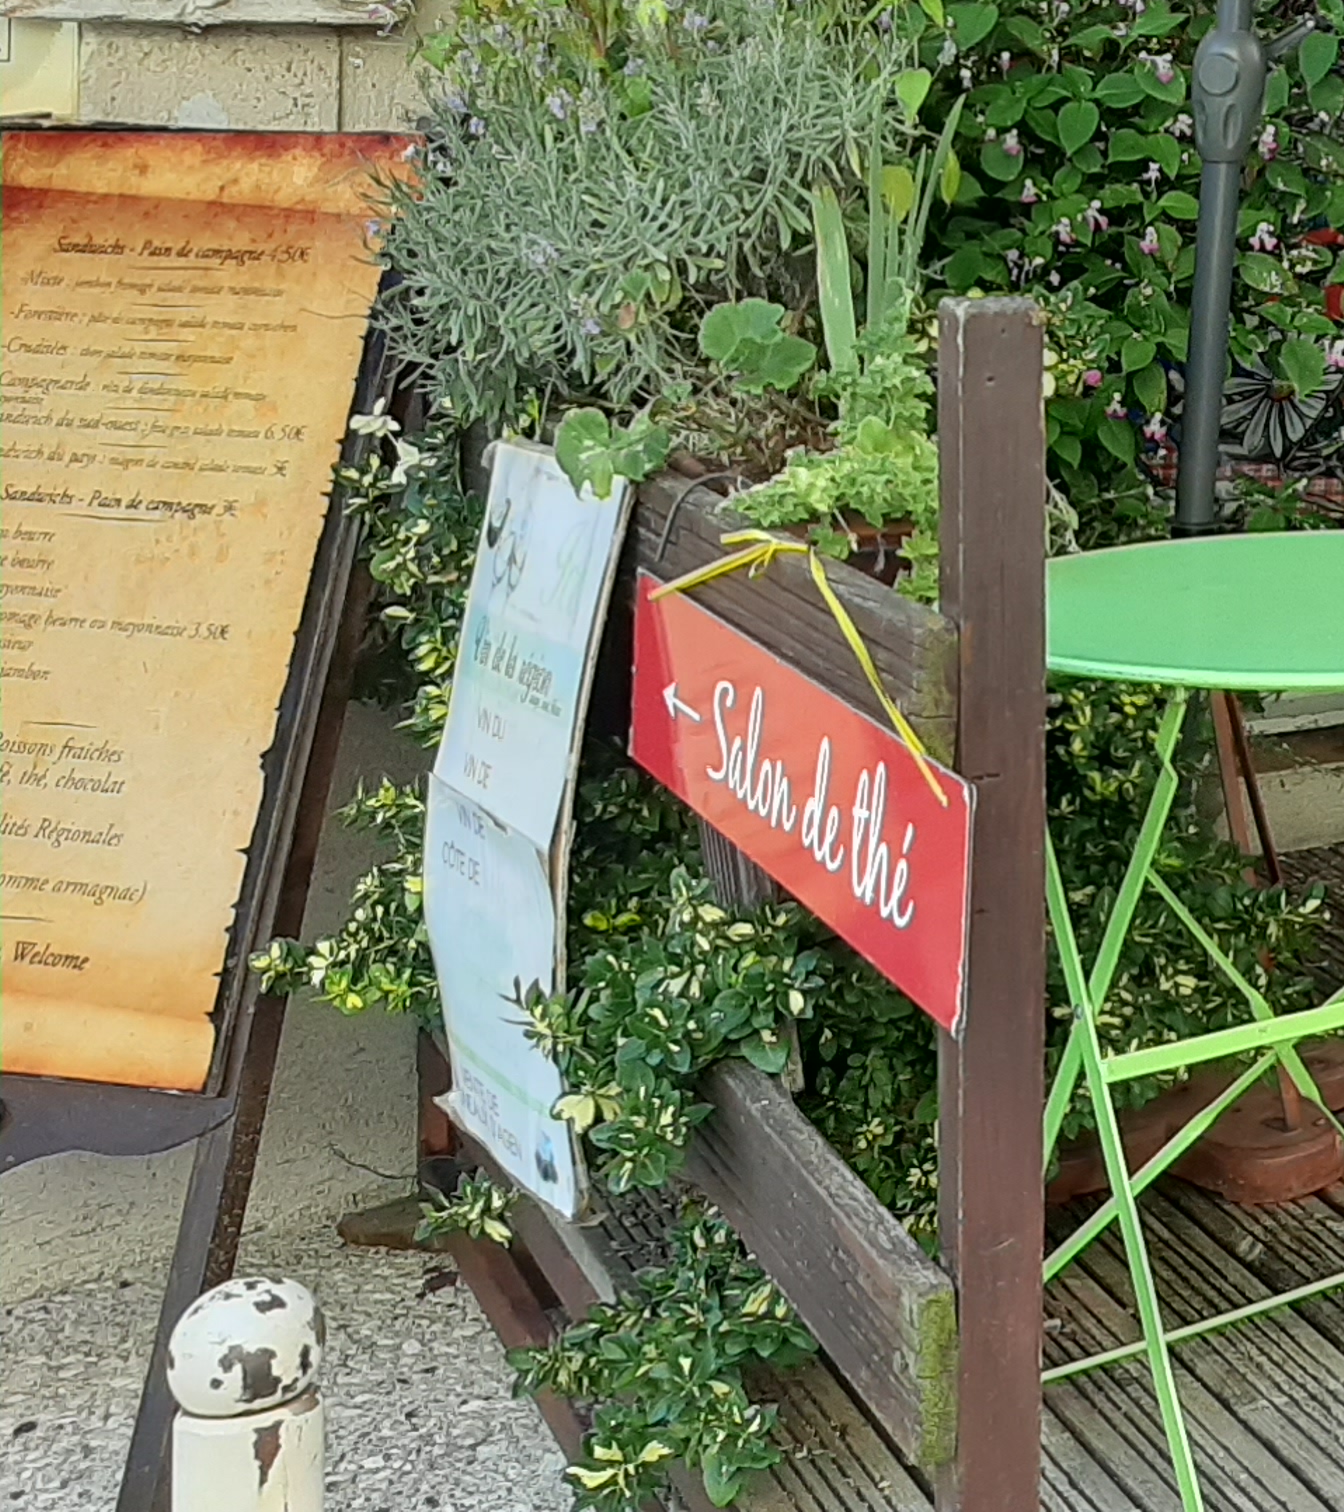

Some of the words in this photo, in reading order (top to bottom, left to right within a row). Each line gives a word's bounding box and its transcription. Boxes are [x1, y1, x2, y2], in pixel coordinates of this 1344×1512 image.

[87, 488, 122, 509] Pain
[124, 491, 142, 510] de
[54, 768, 126, 795] chocolat
[705, 680, 798, 833] Salon
[801, 735, 845, 873] de
[851, 760, 916, 929] thé
[33, 816, 125, 849] Régionales
[51, 879, 149, 907] armagnac)
[12, 940, 91, 972] Welcome
